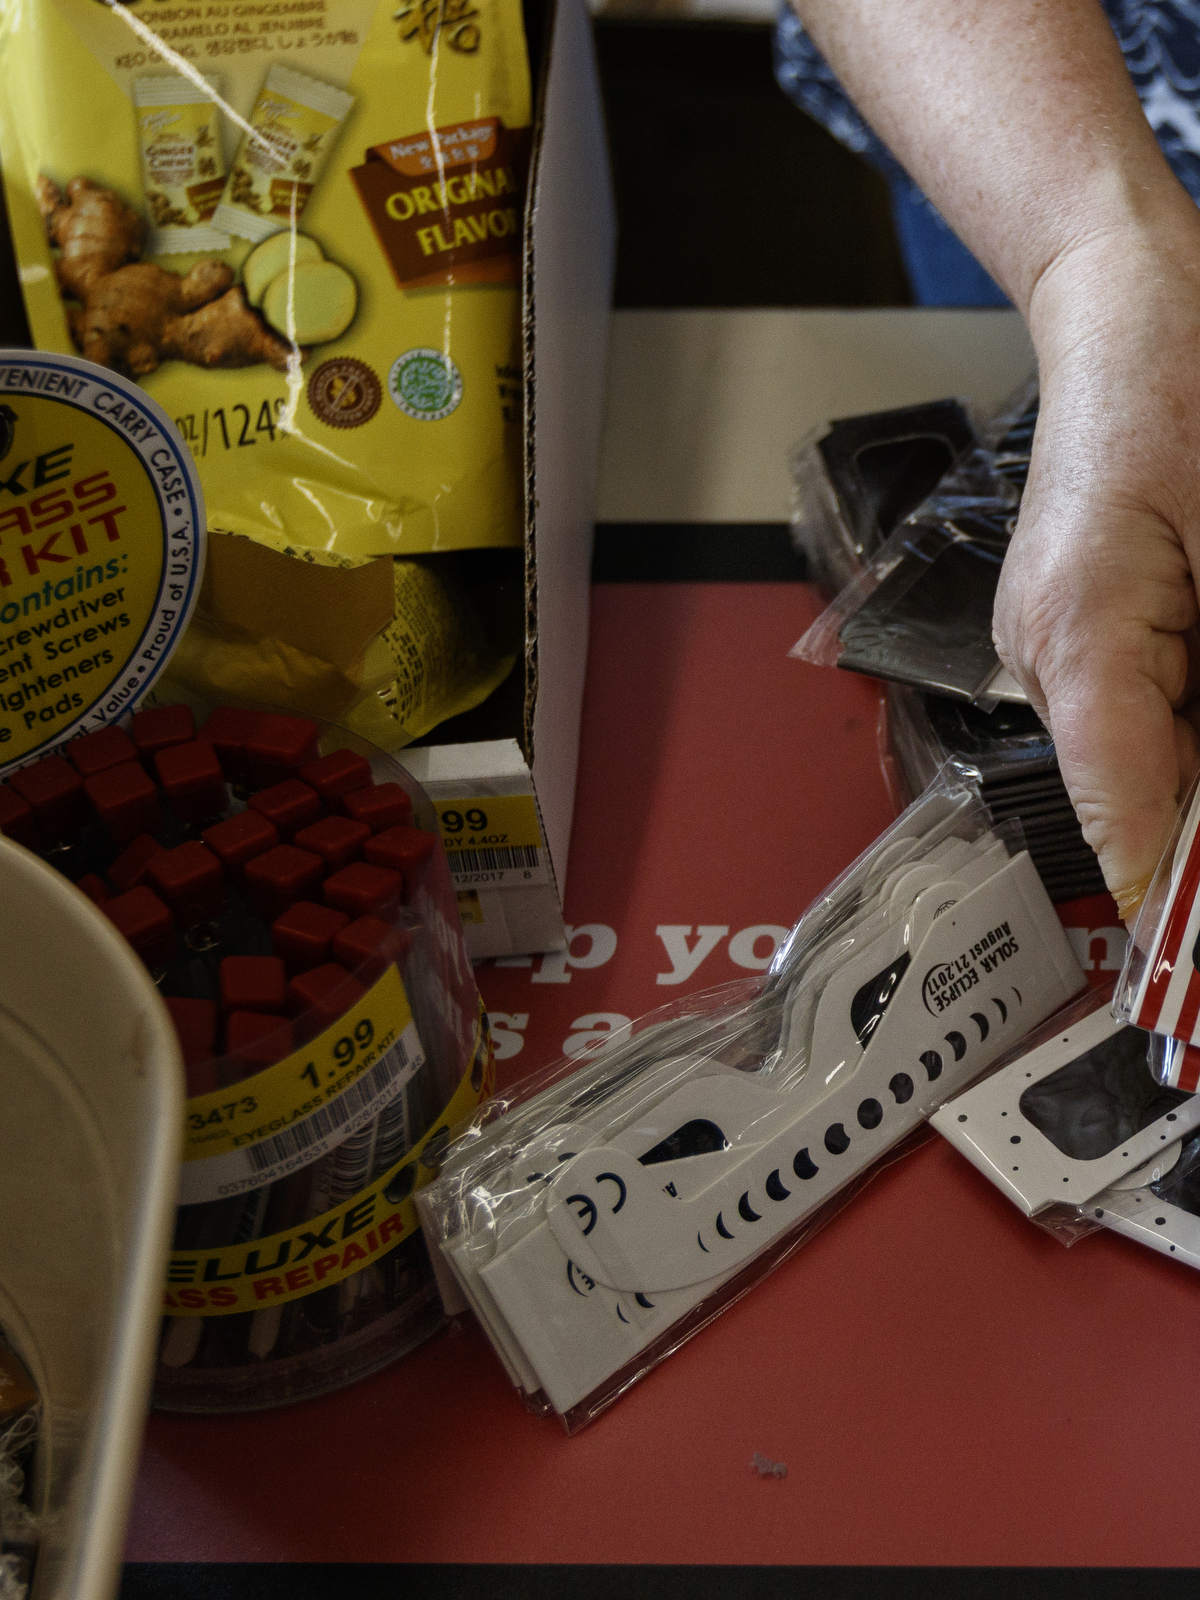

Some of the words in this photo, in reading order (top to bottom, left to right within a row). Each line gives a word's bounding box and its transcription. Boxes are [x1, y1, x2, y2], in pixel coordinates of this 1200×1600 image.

[94, 392, 157, 443] CARRY
[151, 449, 187, 504] CASE
[22, 505, 127, 576] KIT
[171, 520, 191, 576] U.S.A.
[170, 583, 184, 601] of
[44, 612, 131, 661] Screws
[143, 609, 176, 661] Proud
[23, 691, 84, 730] Pads
[92, 677, 139, 723] Value
[523, 871, 532, 880] 8
[968, 920, 1012, 961] August
[980, 936, 1019, 974] SOLAR
[933, 967, 980, 1013] ECLIPSE
[300, 1018, 375, 1089] 1.99
[232, 1095, 323, 1148] EYEGLASS
[325, 1053, 377, 1098] REPAIR
[378, 1027, 396, 1052] KIT
[188, 1096, 258, 1130] 3473
[252, 1212, 405, 1300] REPAIR
